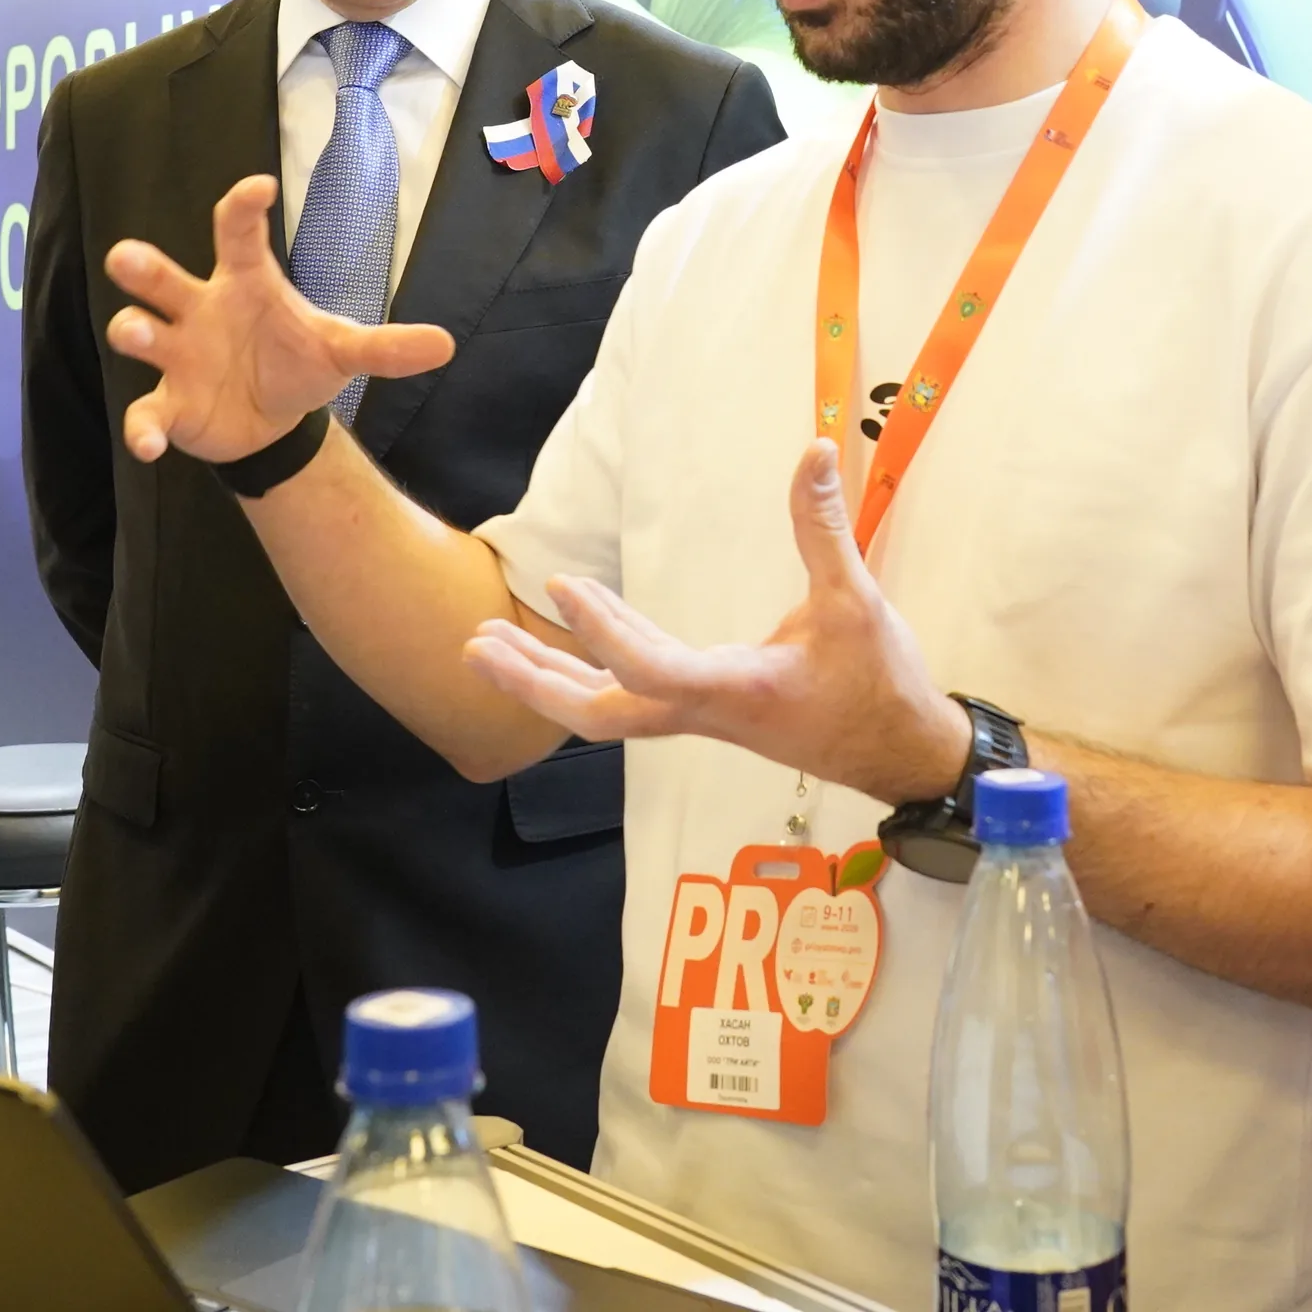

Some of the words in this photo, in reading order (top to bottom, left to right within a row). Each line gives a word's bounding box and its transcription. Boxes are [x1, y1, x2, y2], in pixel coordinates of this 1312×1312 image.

[823, 904, 853, 922] 9-11
[720, 1018, 751, 1030] ХАСАН
[718, 1035, 750, 1047] ОХТОВ
